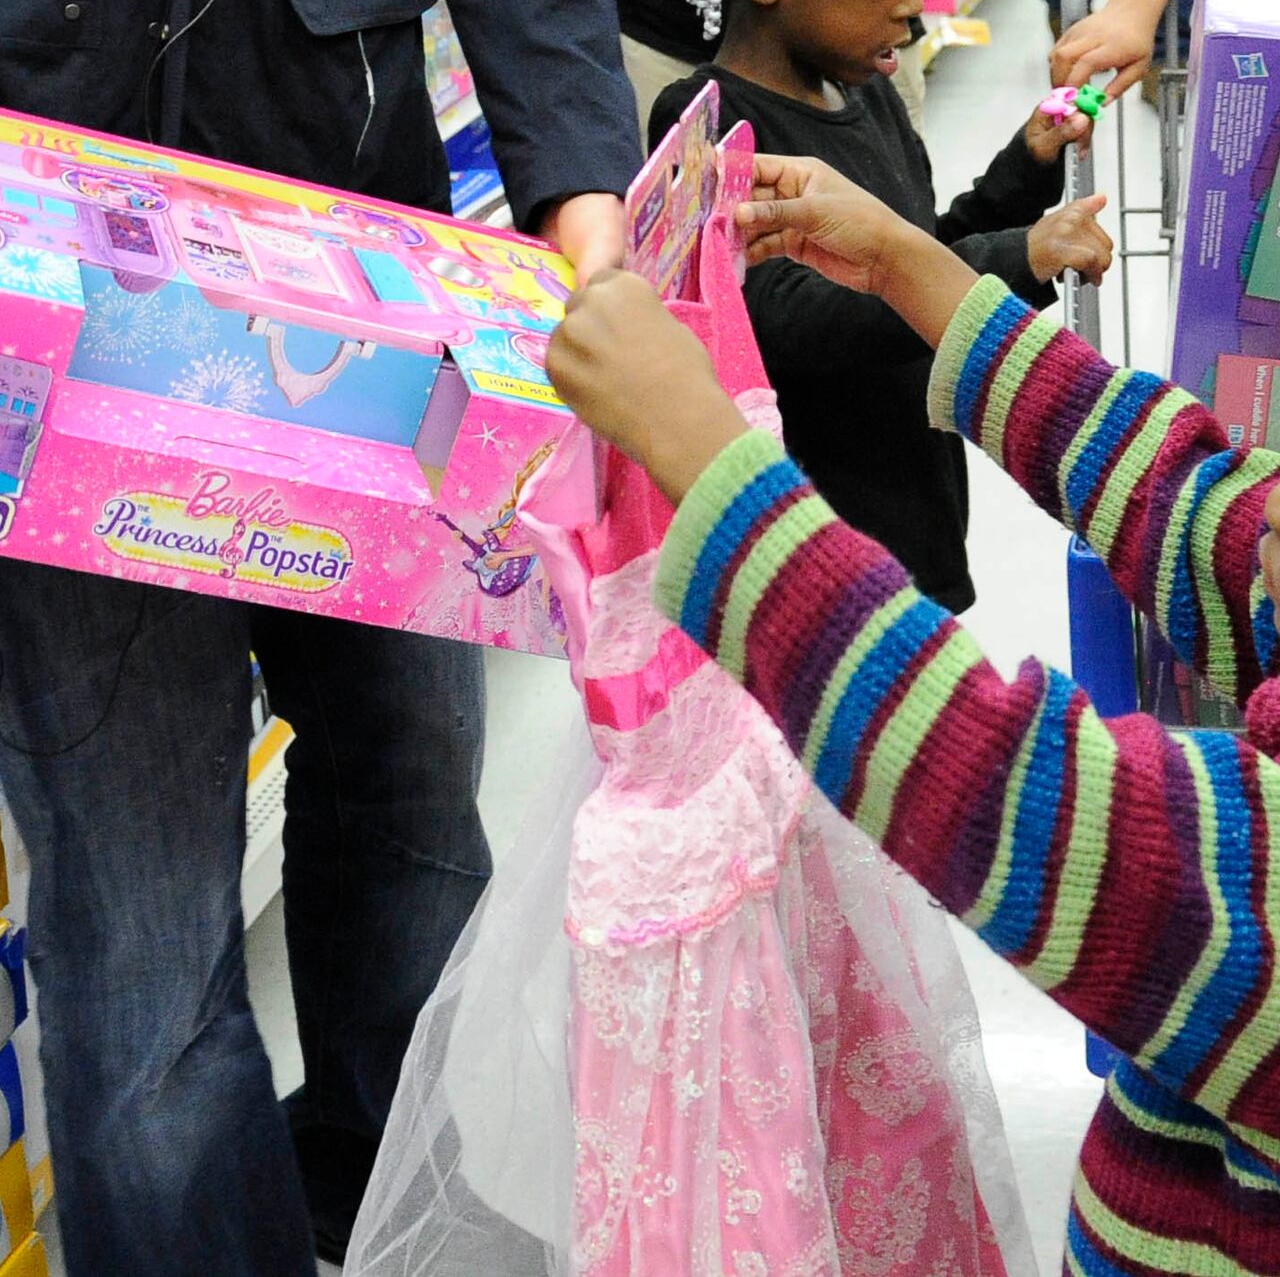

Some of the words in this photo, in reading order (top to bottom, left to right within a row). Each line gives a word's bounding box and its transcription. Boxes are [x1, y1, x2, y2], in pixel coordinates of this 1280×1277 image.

[1254, 364, 1269, 391] When
[1252, 397, 1264, 427] cuddle
[136, 503, 151, 514] THE
[186, 471, 293, 526] Barbie
[94, 499, 220, 556] Princess
[245, 530, 354, 581] Popstar
